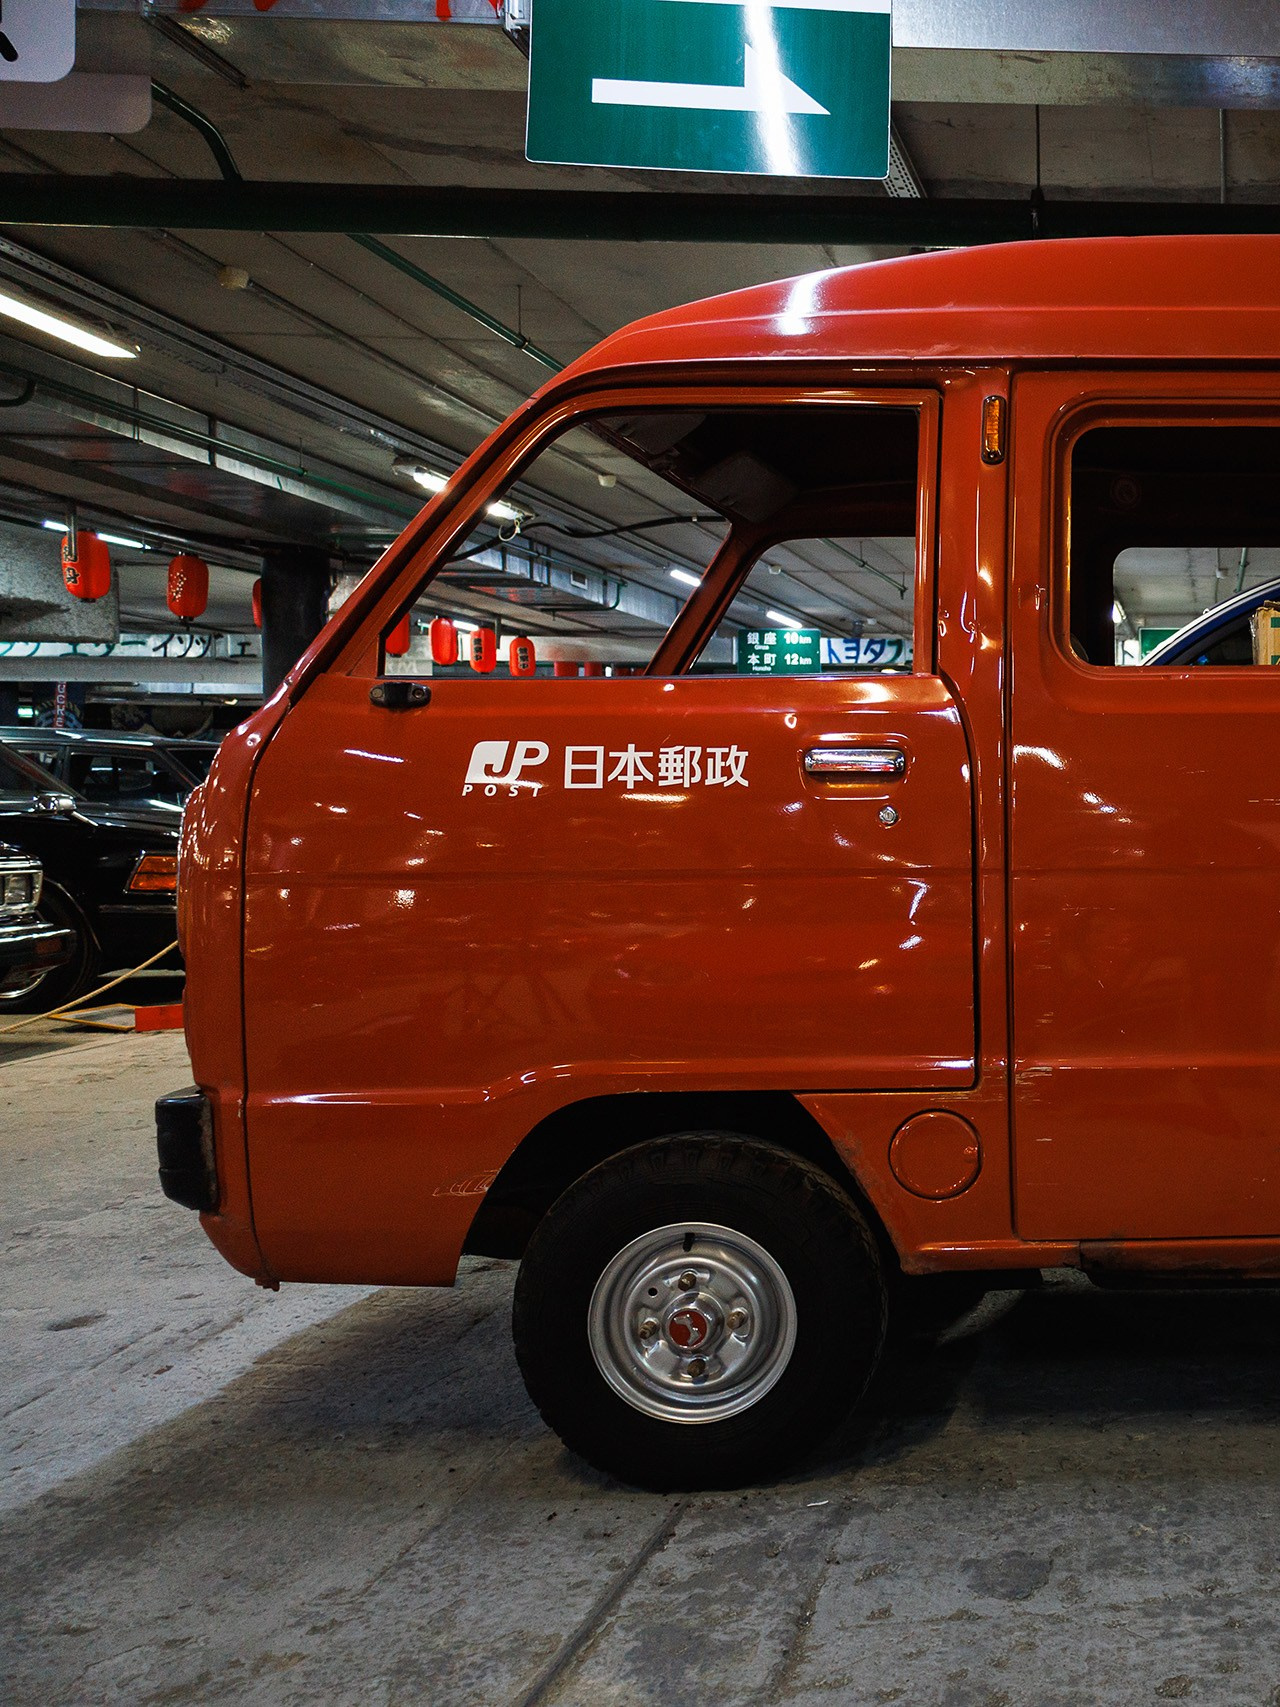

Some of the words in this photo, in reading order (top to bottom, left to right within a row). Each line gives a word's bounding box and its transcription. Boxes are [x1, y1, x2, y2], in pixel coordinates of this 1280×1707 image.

[747, 632, 777, 645] 銀座
[747, 653, 777, 666] 本町
[465, 740, 550, 784] JP
[564, 743, 749, 789] 日本郵政
[461, 784, 543, 798] POST
